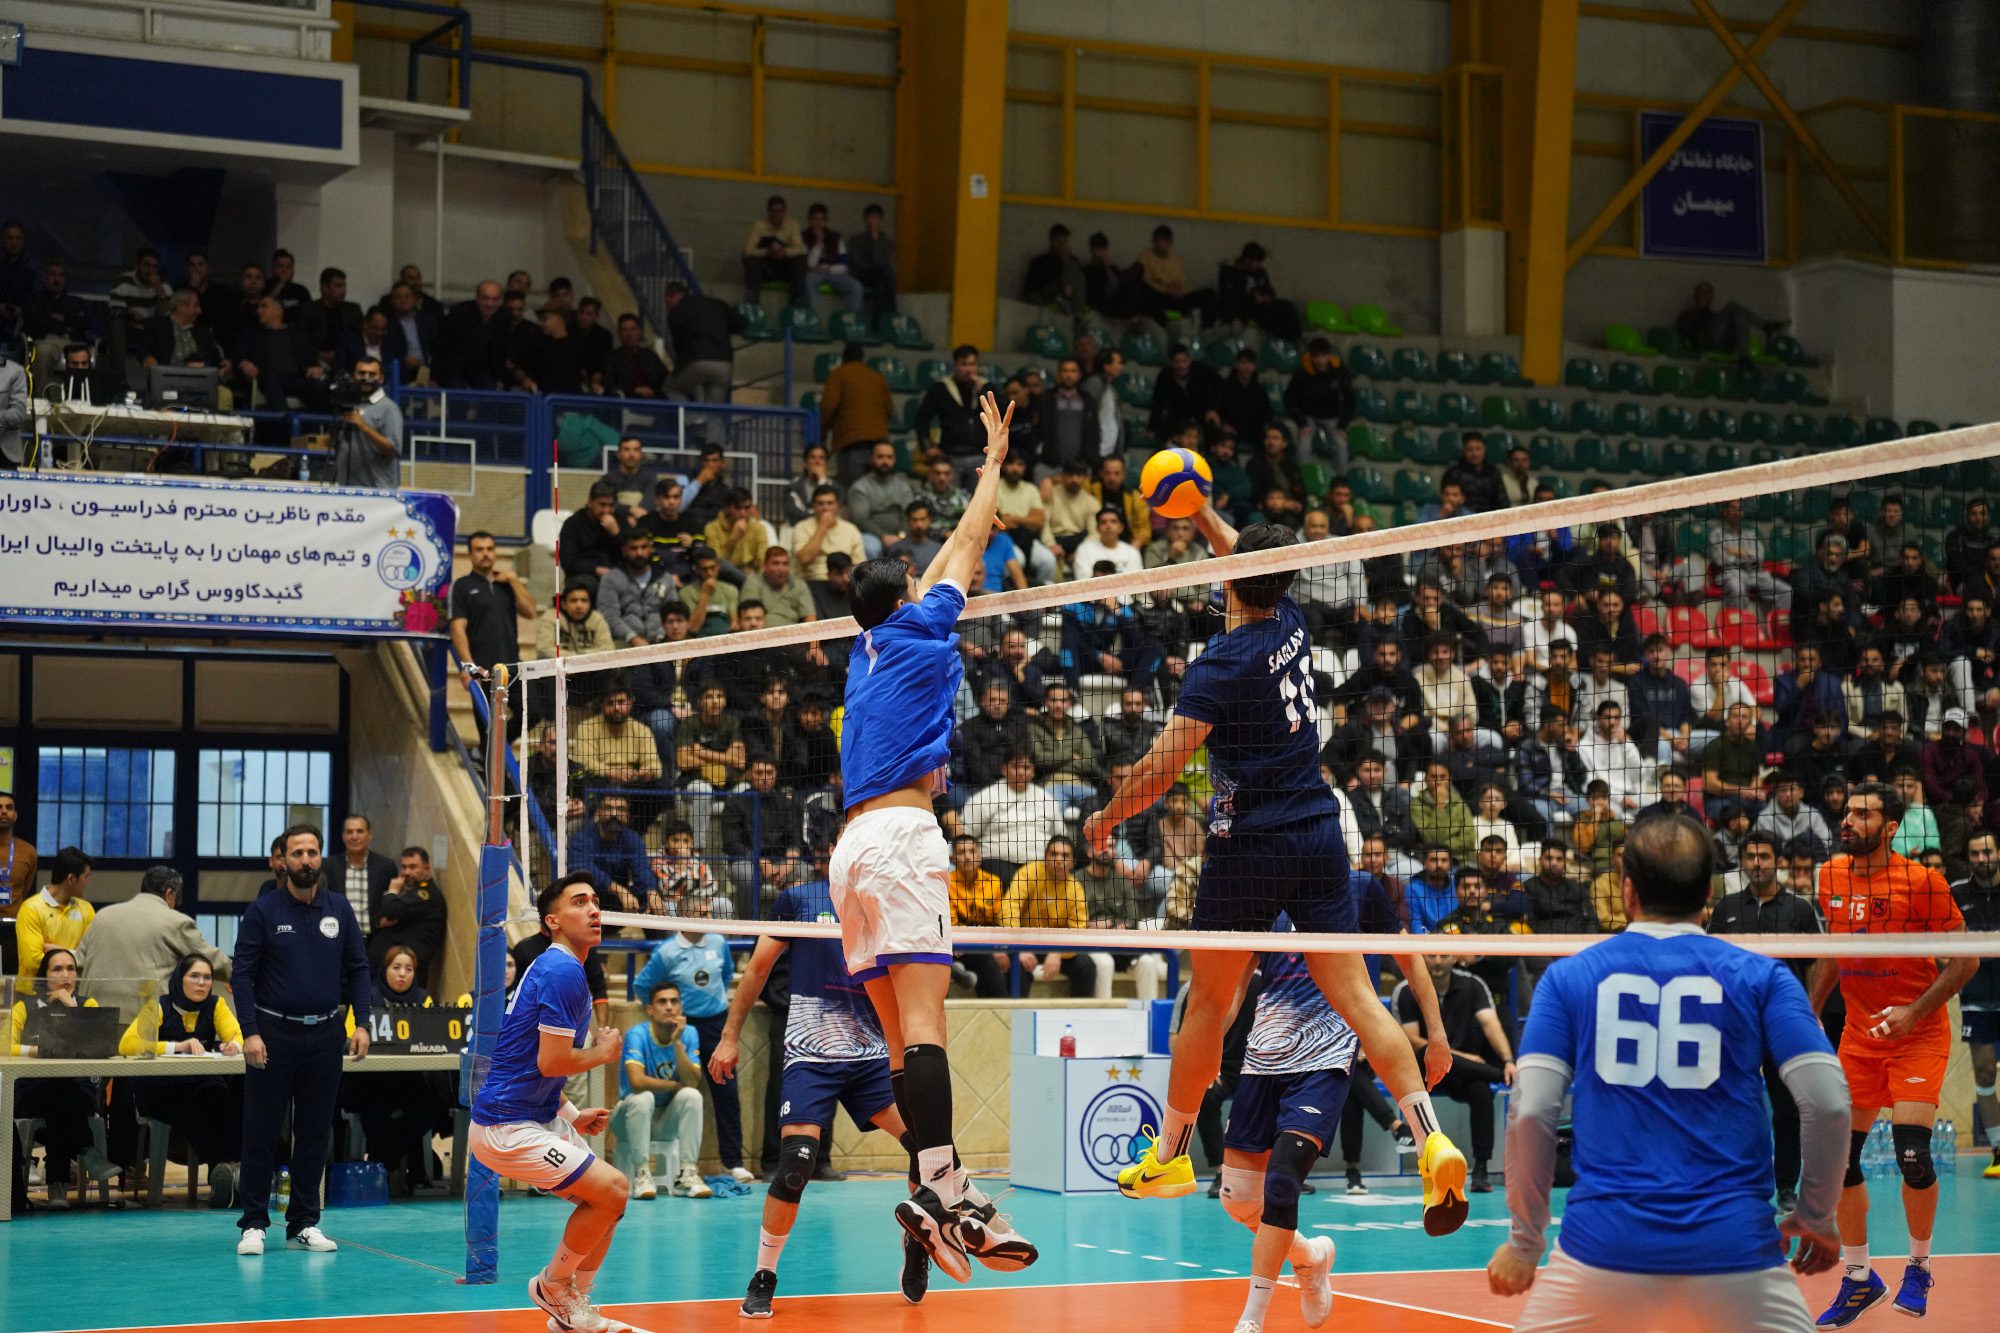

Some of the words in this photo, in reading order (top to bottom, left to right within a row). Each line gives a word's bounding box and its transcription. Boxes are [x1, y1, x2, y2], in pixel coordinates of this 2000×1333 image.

[184, 504, 237, 521] محترم
[244, 505, 310, 525] ناظرین
[317, 509, 366, 526] مقدم
[0, 534, 29, 554] ایرا
[36, 536, 104, 557] والیبال
[110, 538, 178, 563] پایتخت
[185, 544, 204, 561] به
[210, 543, 222, 562] را
[228, 544, 281, 563] مهمان
[361, 553, 371, 567] و
[54, 579, 132, 598] میداریم
[139, 579, 190, 601] گرامی
[1849, 902, 1866, 921] 15
[937, 914, 944, 938] 1
[369, 1014, 394, 1042] 14
[397, 1020, 410, 1040] 0
[448, 1020, 462, 1040] 0
[1595, 972, 1724, 1090] 66
[543, 1147, 567, 1169] 18
